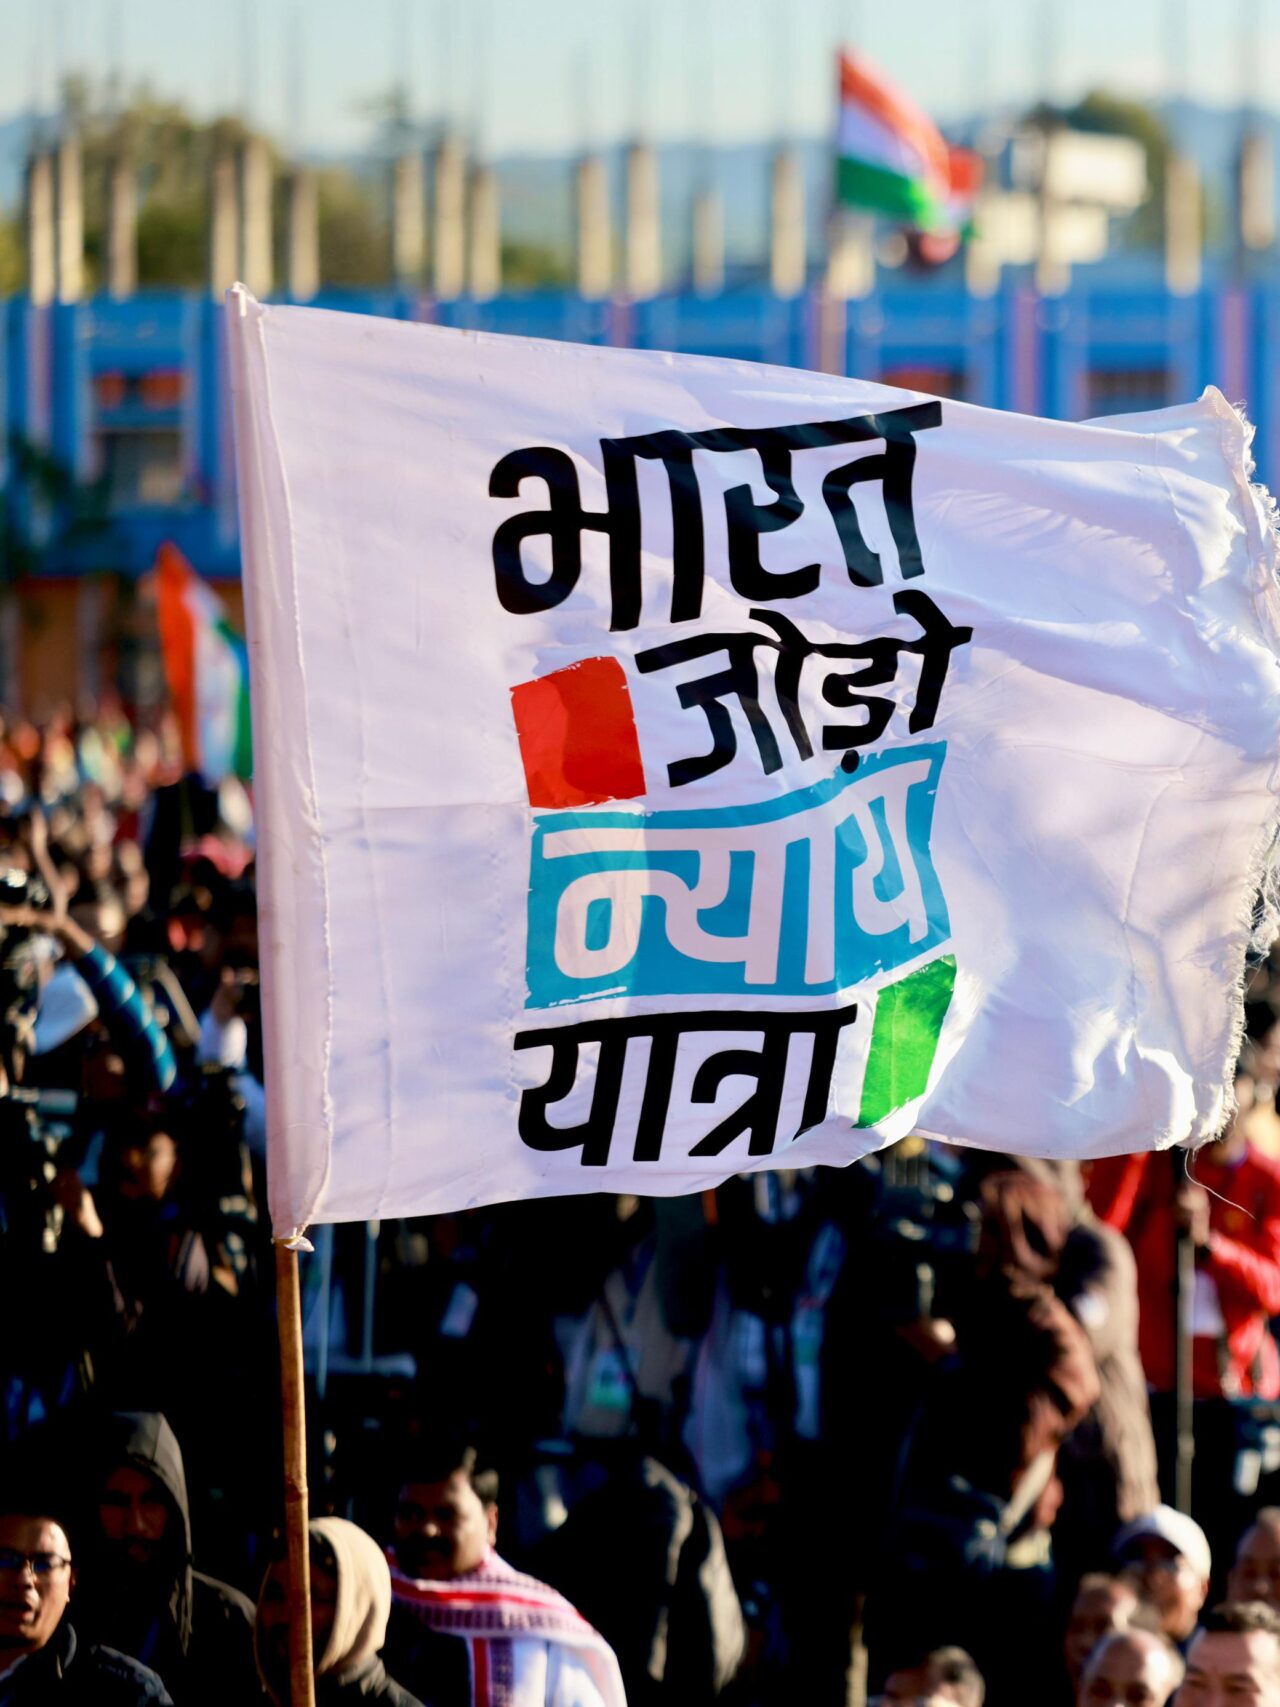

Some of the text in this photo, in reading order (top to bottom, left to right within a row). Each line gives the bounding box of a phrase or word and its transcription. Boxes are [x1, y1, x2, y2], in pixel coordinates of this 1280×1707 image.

[488, 401, 942, 632] भारत
[635, 590, 973, 788] जोड़ो
[542, 759, 934, 985] न्याय
[513, 1004, 859, 1167] यात्रा
